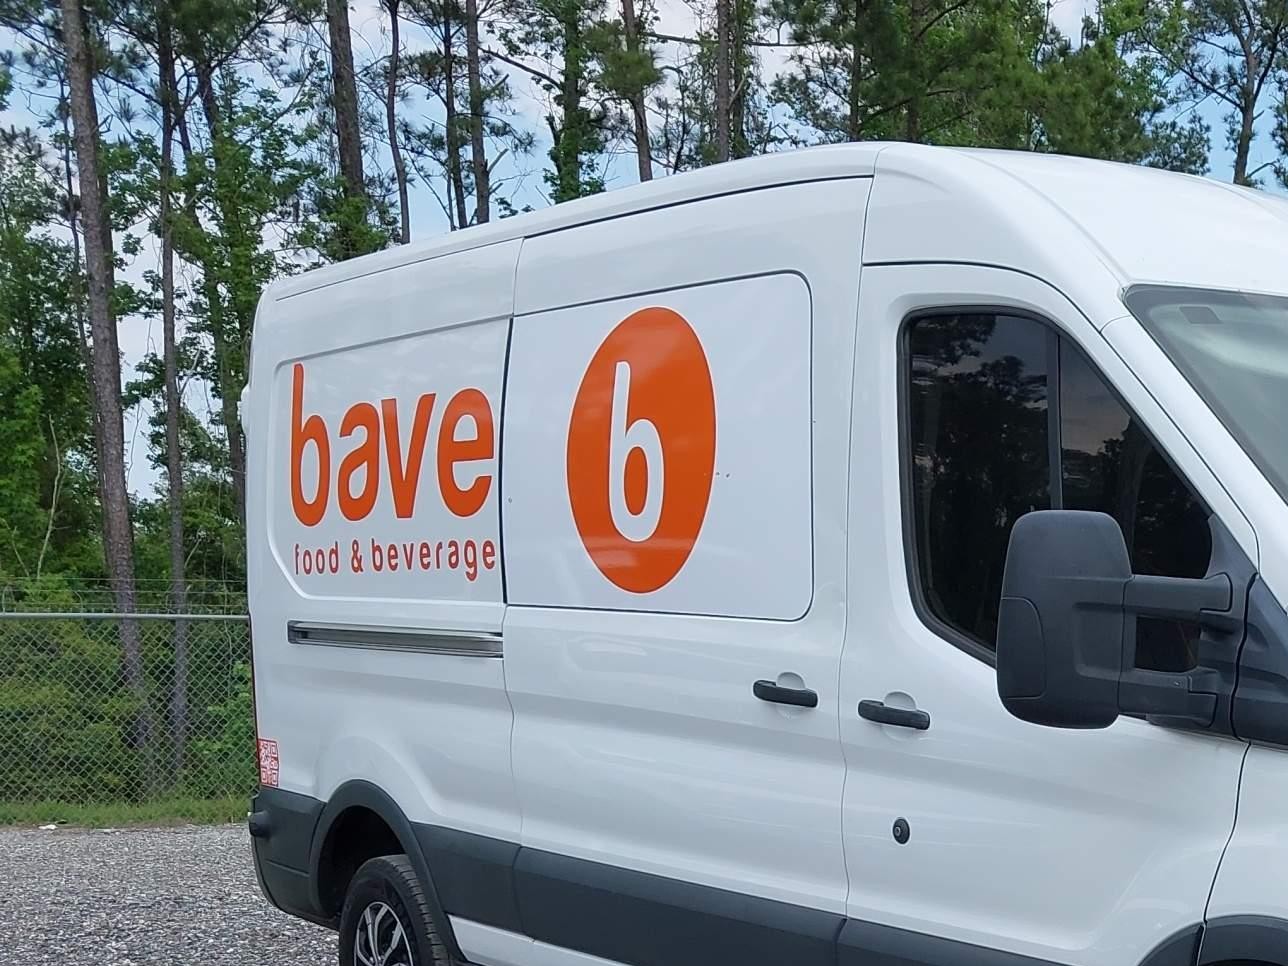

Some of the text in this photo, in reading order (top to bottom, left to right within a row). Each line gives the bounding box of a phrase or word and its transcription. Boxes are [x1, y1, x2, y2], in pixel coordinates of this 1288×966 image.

[290, 362, 495, 527] bave
[609, 360, 665, 543] b
[294, 537, 496, 581] food & beverage
